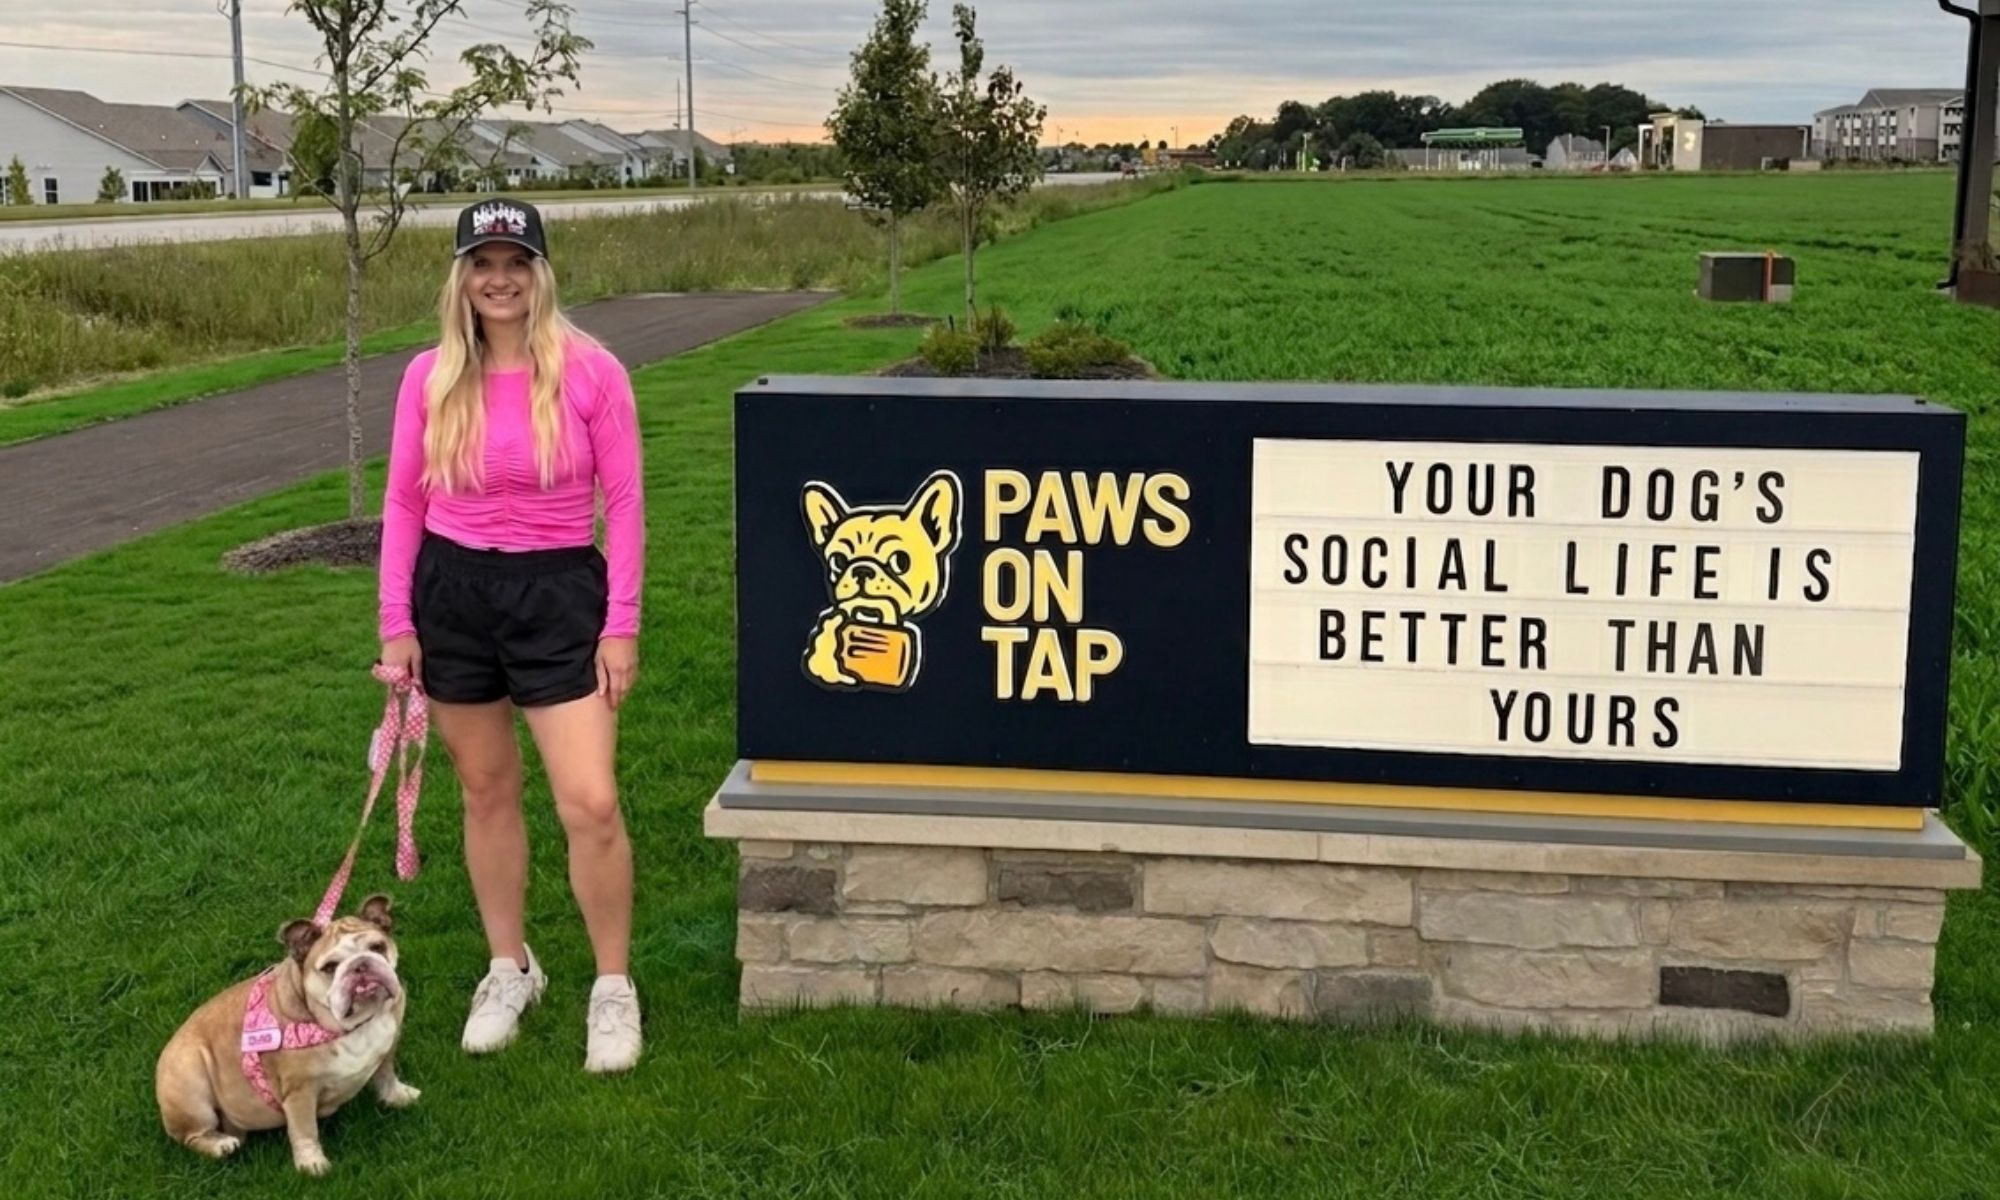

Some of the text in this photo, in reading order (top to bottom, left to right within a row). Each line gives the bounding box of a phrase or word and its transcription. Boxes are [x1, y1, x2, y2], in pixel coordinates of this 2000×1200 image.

[984, 469, 1191, 546] PAWS
[1386, 462, 1785, 523] YOUR DOG'S
[983, 549, 1083, 623] ON
[1284, 534, 1832, 602] SOCIAL LIFE IS
[981, 626, 1123, 701] TAP
[1319, 609, 1764, 675] BETTER THAN
[1490, 690, 1680, 748] YOURS
